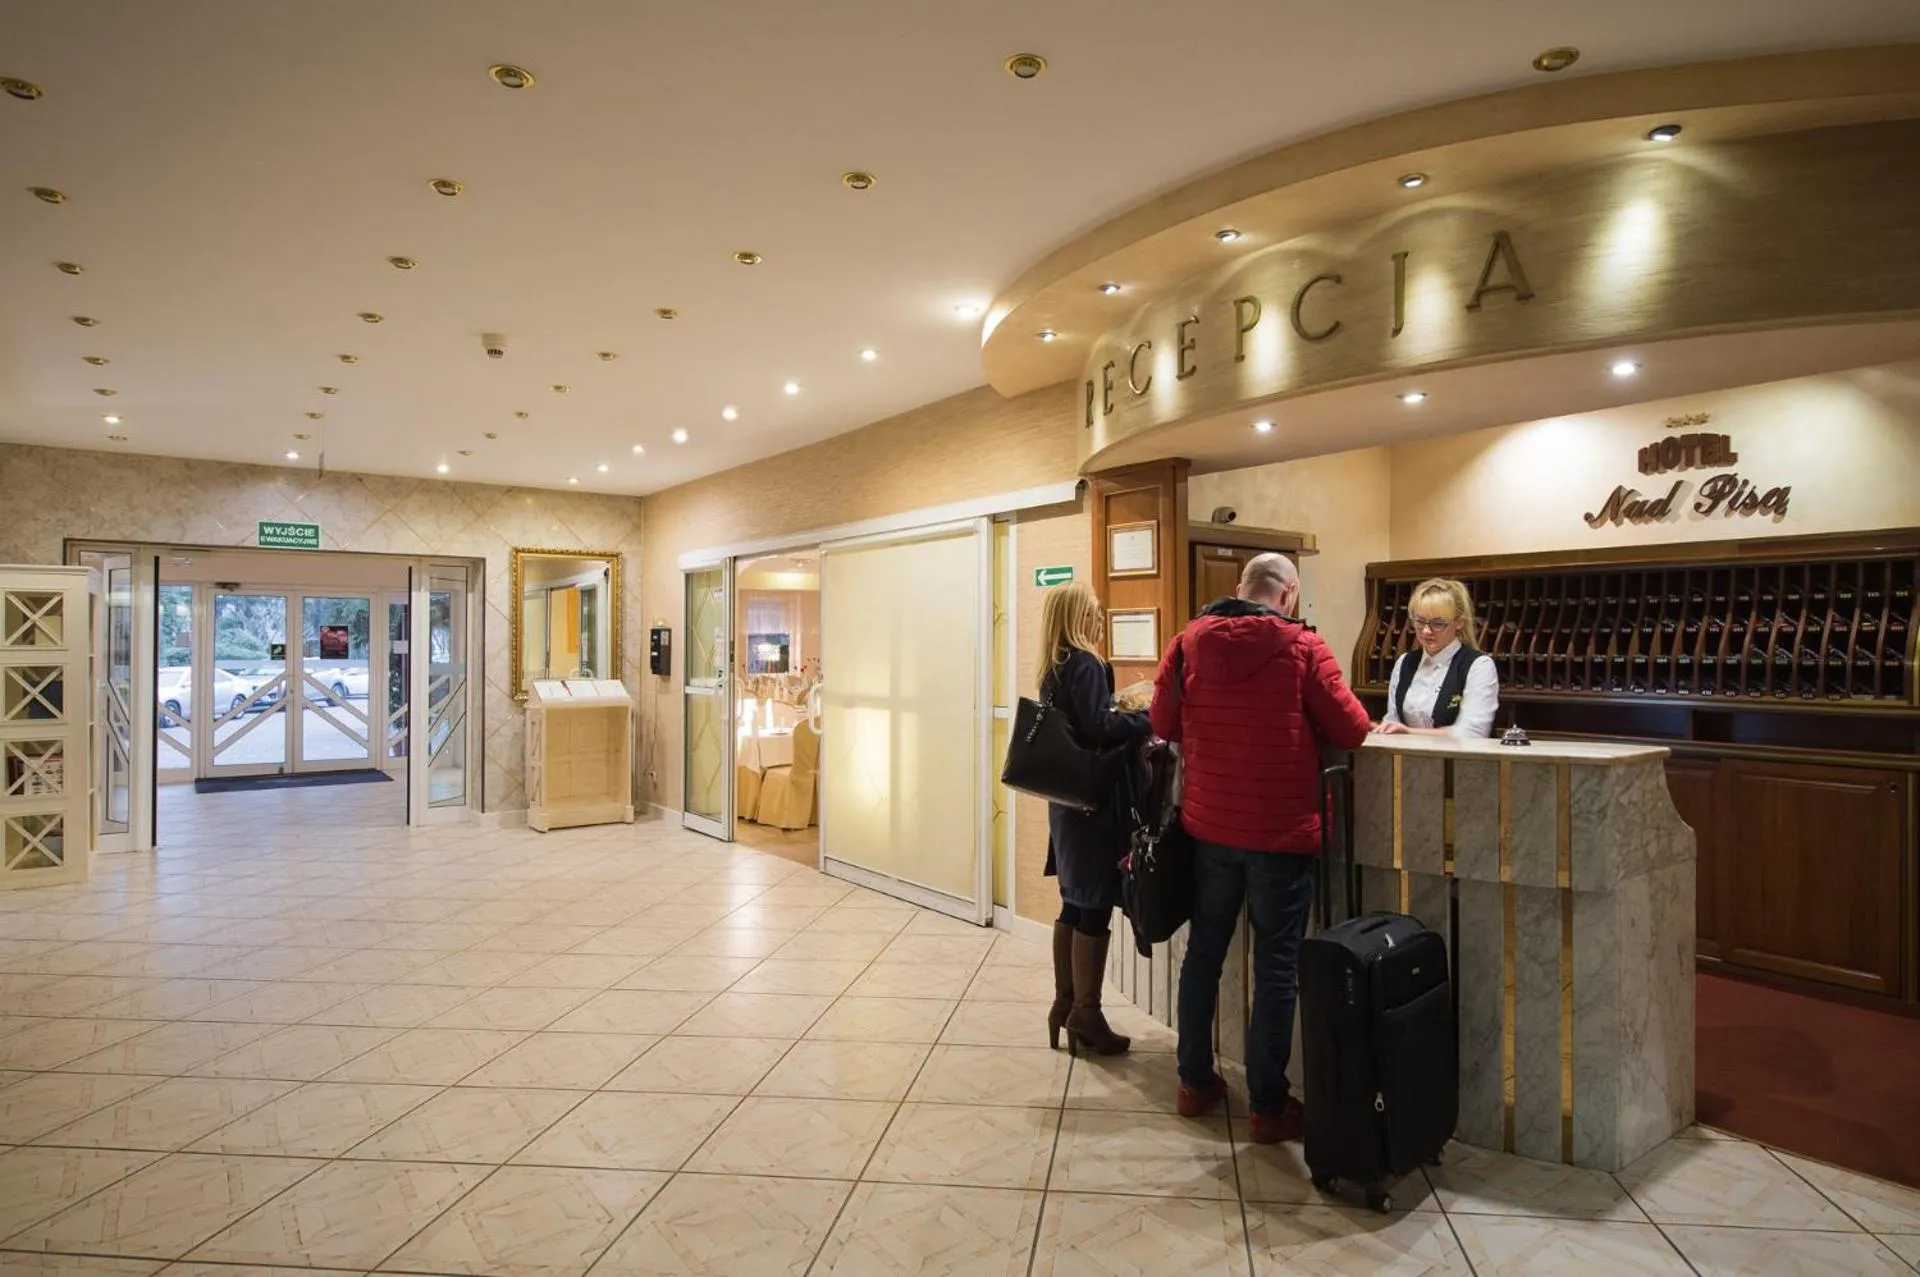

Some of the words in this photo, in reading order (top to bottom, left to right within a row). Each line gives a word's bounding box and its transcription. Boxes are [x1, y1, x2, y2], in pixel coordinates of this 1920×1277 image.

[1085, 229, 1536, 429] RECEPCJA
[1638, 433, 1738, 474] HOTEL
[1584, 480, 1684, 526] Nad
[260, 536, 318, 545] EWAKUACYJNE
[263, 526, 316, 537] WYJŚCIE
